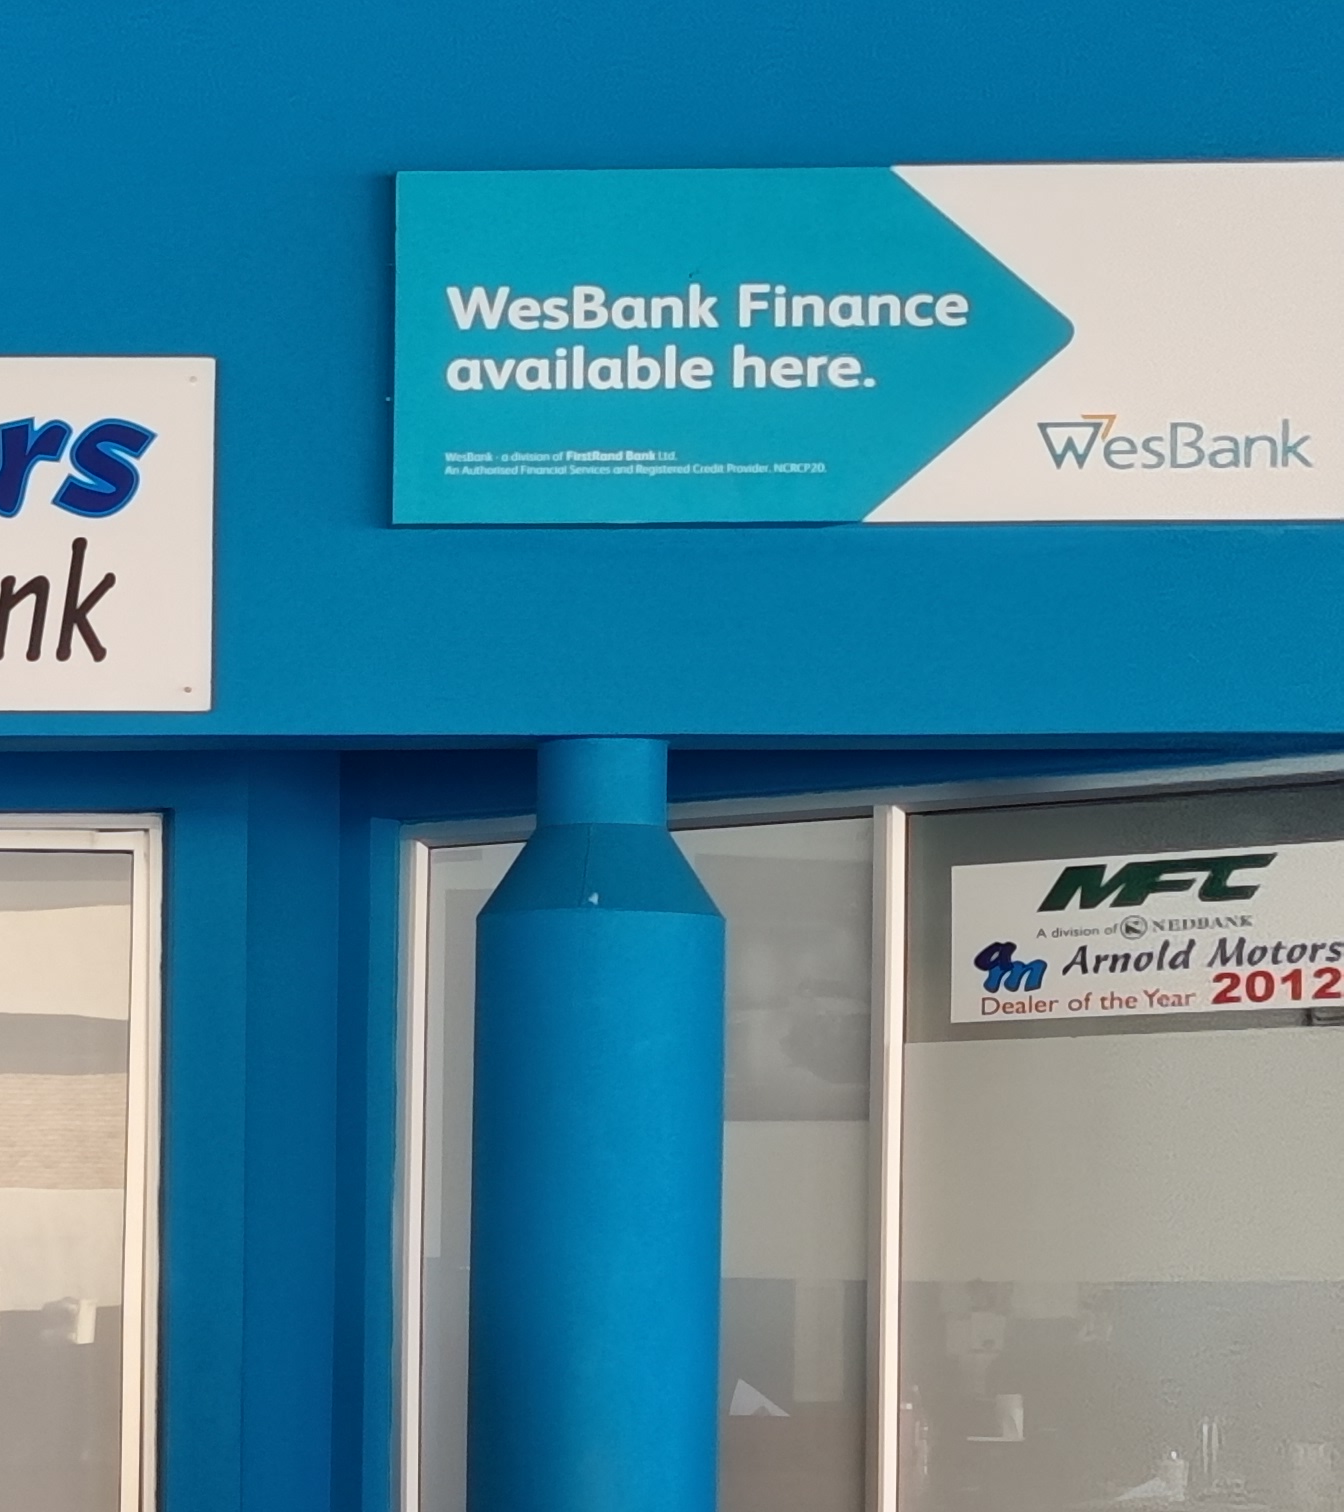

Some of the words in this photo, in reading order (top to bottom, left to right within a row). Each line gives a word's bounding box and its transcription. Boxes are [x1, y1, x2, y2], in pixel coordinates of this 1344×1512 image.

[445, 283, 720, 330] WesBank
[739, 283, 970, 328] Finance
[445, 344, 715, 391] available
[732, 344, 876, 389] here.
[444, 451, 494, 463] WesBank
[510, 451, 551, 462] division
[552, 451, 564, 462] of
[565, 450, 624, 462] FirstRand
[625, 450, 656, 462] Bank
[1037, 413, 1314, 471] WesBank
[444, 465, 460, 476] An
[462, 465, 519, 476] Authorised
[520, 464, 568, 475] Financial
[569, 465, 611, 475] Services
[612, 464, 634, 474] and
[635, 463, 691, 477] Registered
[692, 463, 724, 474] Credit
[1037, 852, 1278, 912] MFC
[1036, 928, 1048, 939] A
[1051, 926, 1100, 939] division
[1104, 923, 1119, 936] of
[1152, 914, 1254, 933] NEDBANK
[1061, 938, 1197, 977] Arnold
[1206, 936, 1344, 968] Motors
[981, 995, 1060, 1016] Dealer
[1067, 991, 1093, 1012] of
[1099, 991, 1139, 1010] the
[1142, 987, 1197, 1008] Year
[1211, 966, 1343, 1005] 2012
